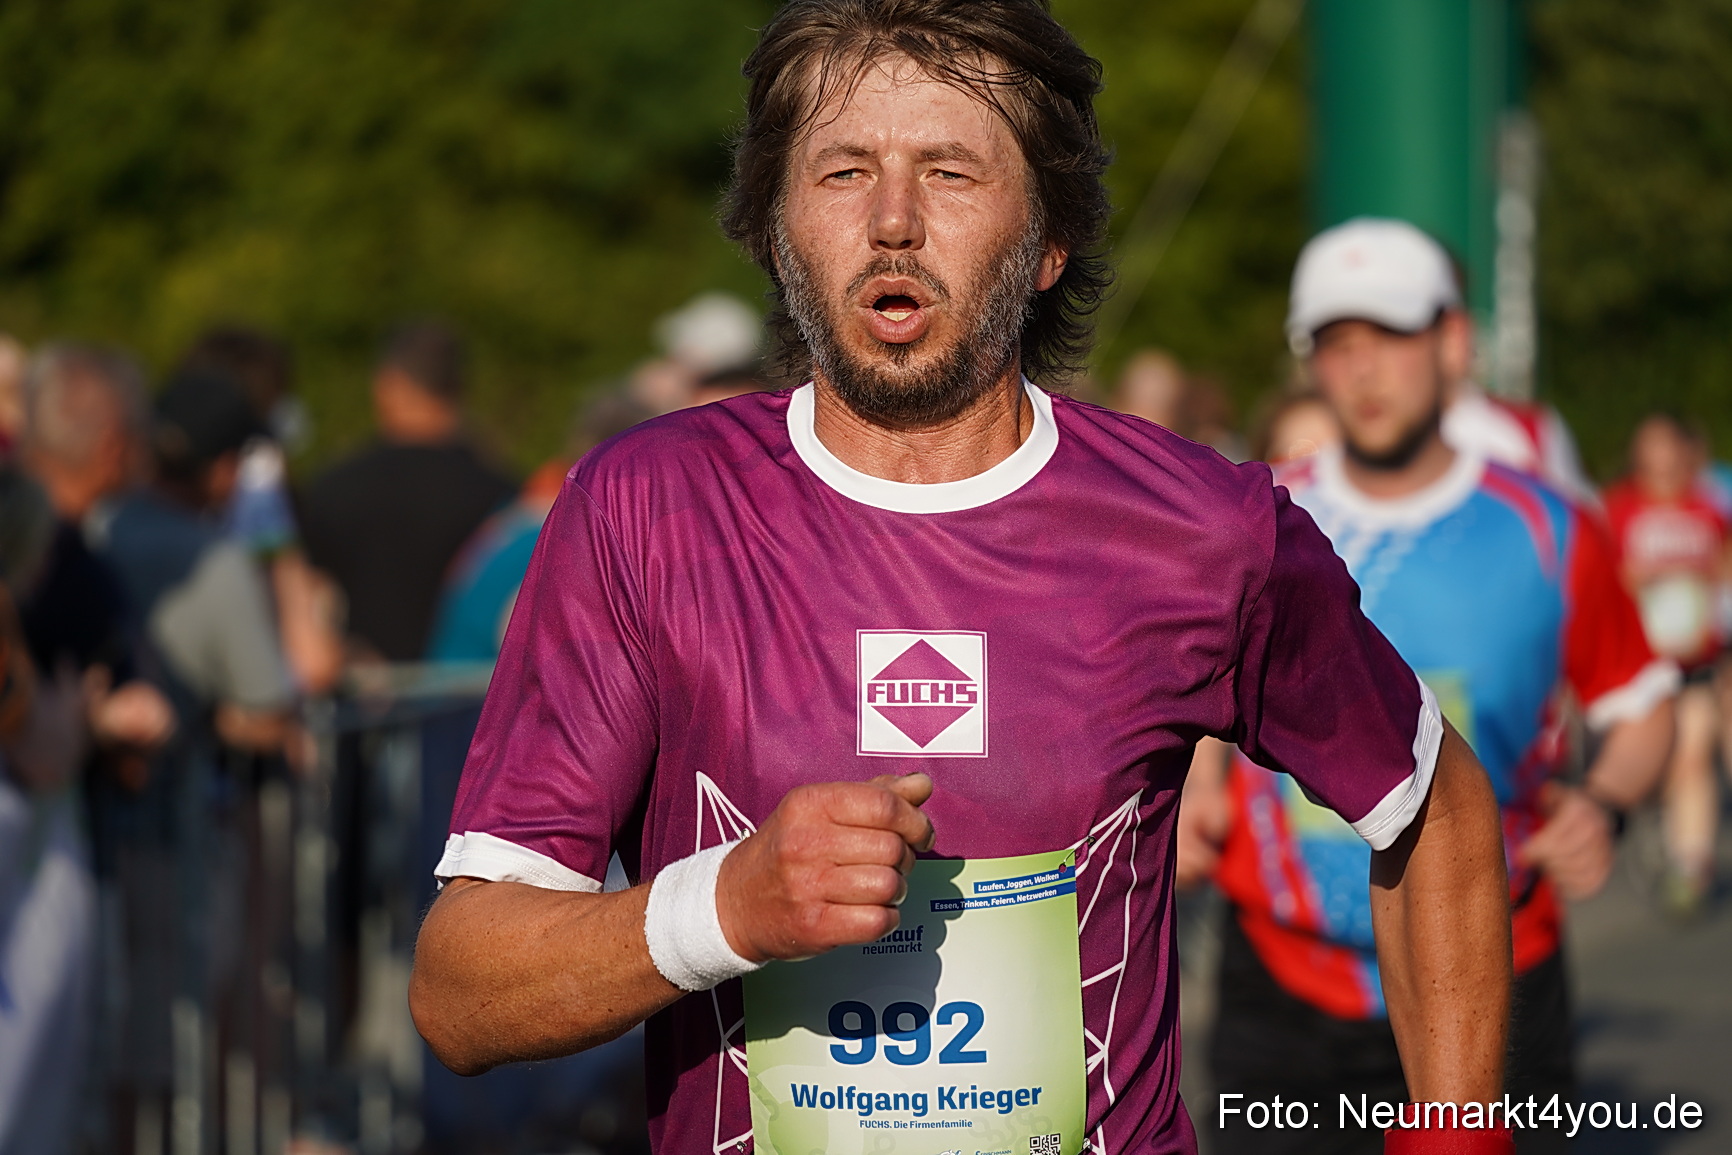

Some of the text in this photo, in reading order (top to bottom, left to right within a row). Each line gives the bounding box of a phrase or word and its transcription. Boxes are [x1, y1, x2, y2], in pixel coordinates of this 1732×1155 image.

[867, 682, 978, 704] FUCHS
[977, 873, 1060, 892] Laufen, Joggen, Walken
[934, 889, 1057, 910] Essen, Trinken, Feiern, Netzwerken
[862, 942, 922, 955] neumarkt
[828, 1001, 987, 1065] 992
[791, 1083, 1042, 1116] Wolfgang Krieger
[859, 1119, 973, 1129] FUCHS. Die Firmenfamilie
